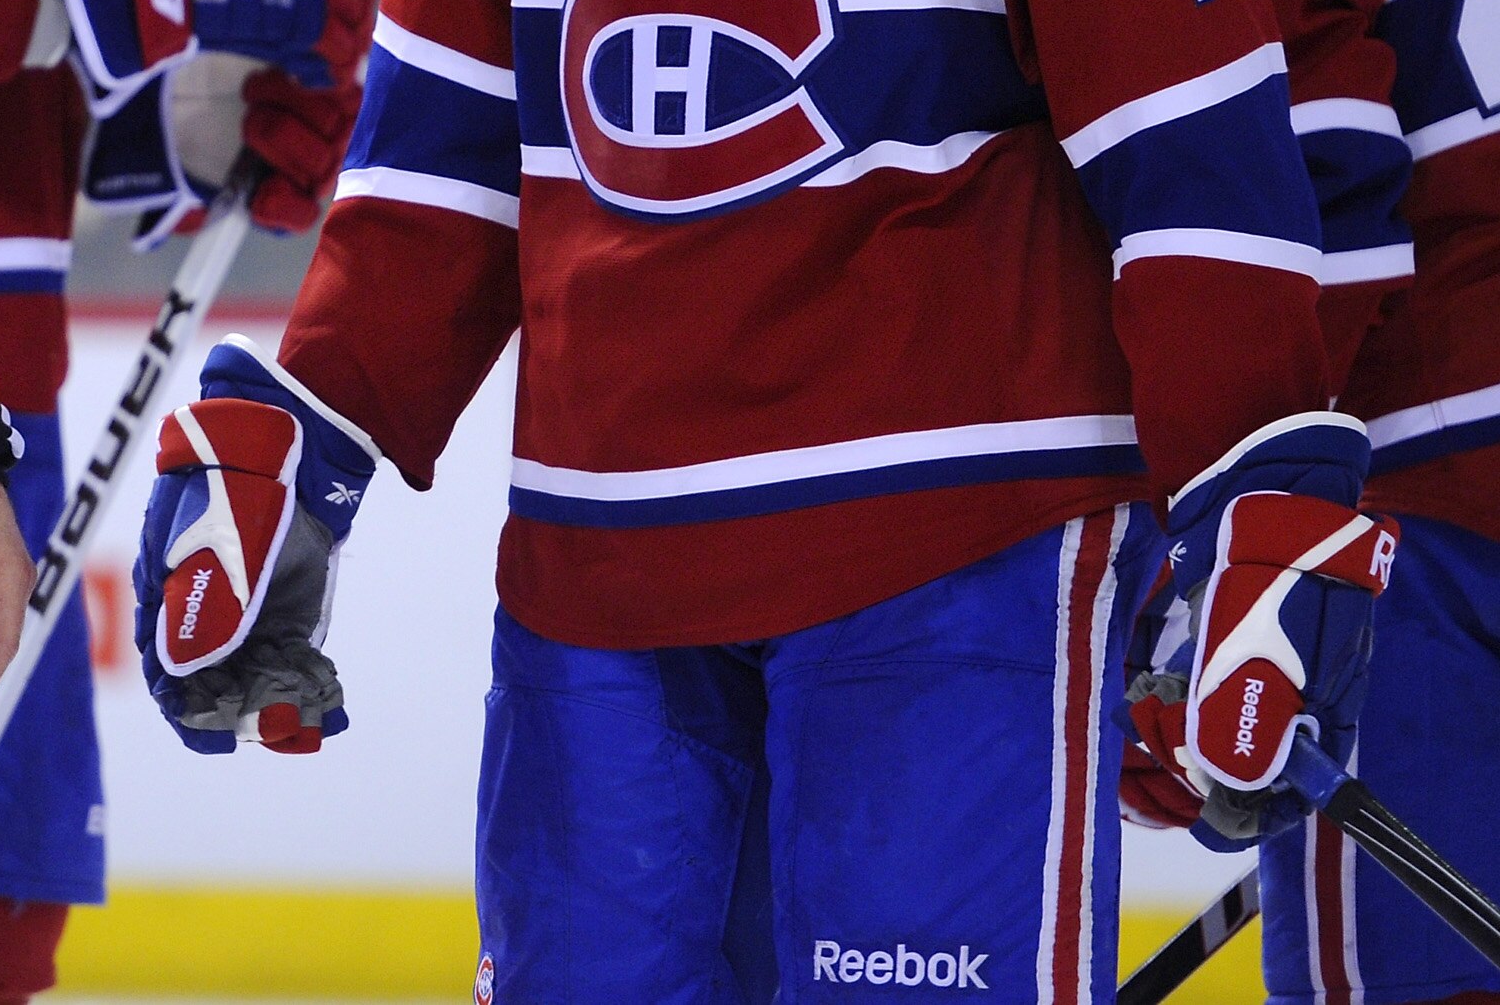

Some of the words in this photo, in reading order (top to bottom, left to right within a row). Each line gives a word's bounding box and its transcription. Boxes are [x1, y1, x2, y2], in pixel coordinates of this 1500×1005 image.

[29, 290, 195, 616] BAUER
[177, 568, 214, 640] Reebok
[1233, 678, 1265, 757] Reebok
[813, 939, 991, 990] Reebok
